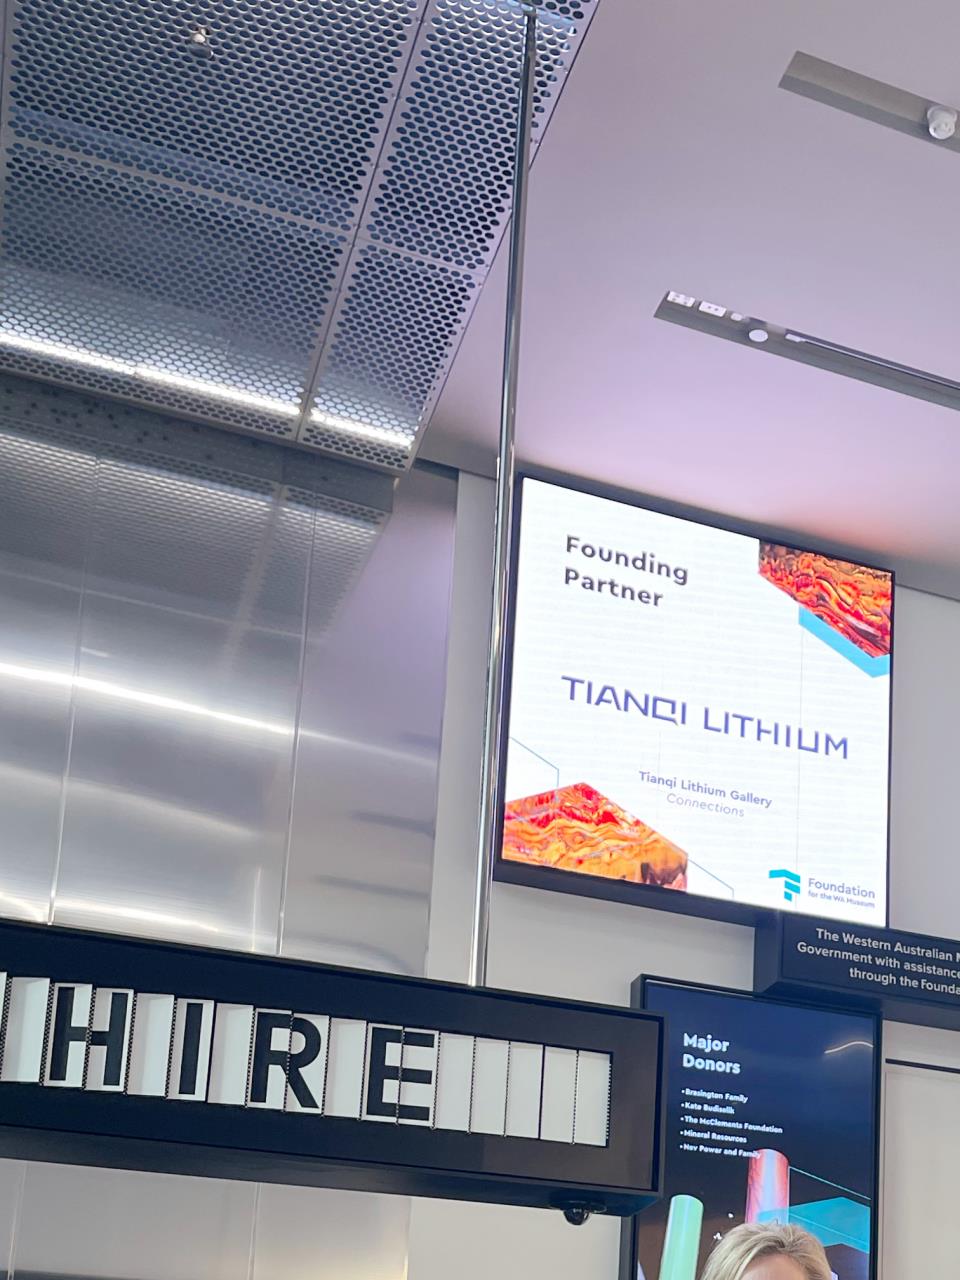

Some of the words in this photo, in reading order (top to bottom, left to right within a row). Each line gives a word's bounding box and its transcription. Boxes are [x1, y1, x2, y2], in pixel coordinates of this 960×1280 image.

[566, 534, 688, 586] Founding
[565, 567, 663, 606] Partner
[561, 675, 687, 726] TIANQI
[704, 706, 848, 759] LITHIUM
[639, 770, 677, 789] Tianqi
[681, 779, 726, 798] Lithium
[730, 790, 772, 808] Gallery
[666, 793, 745, 817] Connections
[808, 877, 875, 899] Foundation
[808, 890, 818, 898] for
[820, 892, 832, 900] the
[833, 895, 845, 903] WA
[847, 897, 875, 908] Museum
[797, 942, 872, 964] Government
[875, 956, 900, 969] with
[816, 928, 839, 942] The
[842, 932, 891, 950] Western
[894, 942, 952, 962] Australian
[849, 967, 896, 986] through
[899, 976, 919, 988] the
[683, 1032, 730, 1053] Major
[49, 986, 435, 1121] HIRE
[683, 1053, 741, 1074] Donors
[684, 1101, 702, 1111] Kate
[725, 1093, 749, 1104] Family
[684, 1115, 698, 1124] The
[699, 1117, 743, 1129] McClements
[744, 1122, 783, 1134] Foundation
[683, 1129, 710, 1139] Mineral
[711, 1133, 747, 1143] Resources
[683, 1143, 699, 1152] Nev
[699, 1145, 723, 1155] Power
[723, 1148, 738, 1156] and
[738, 1149, 761, 1159] Family
